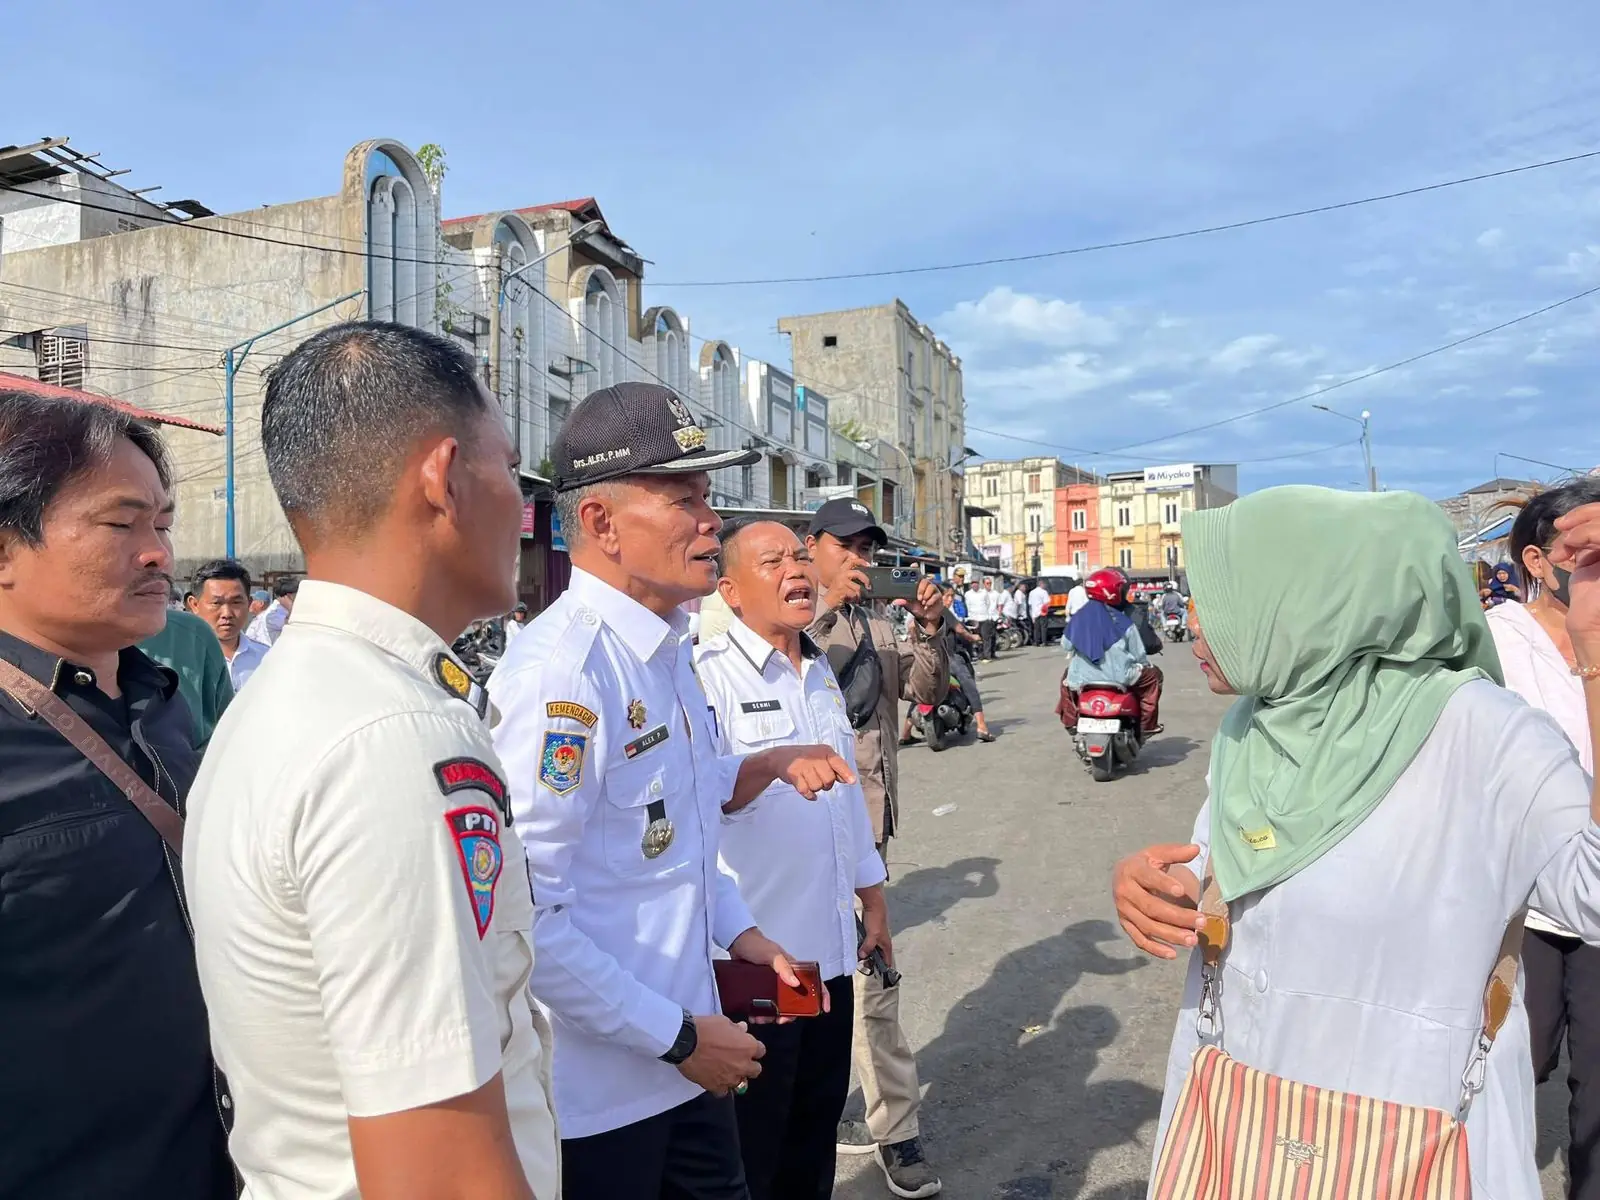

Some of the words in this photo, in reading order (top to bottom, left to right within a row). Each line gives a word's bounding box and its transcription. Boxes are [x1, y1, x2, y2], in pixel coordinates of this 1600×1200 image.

[1157, 469, 1191, 481] Miyako
[549, 703, 594, 724] KEMENDAGRI
[641, 736, 655, 747] ALEX
